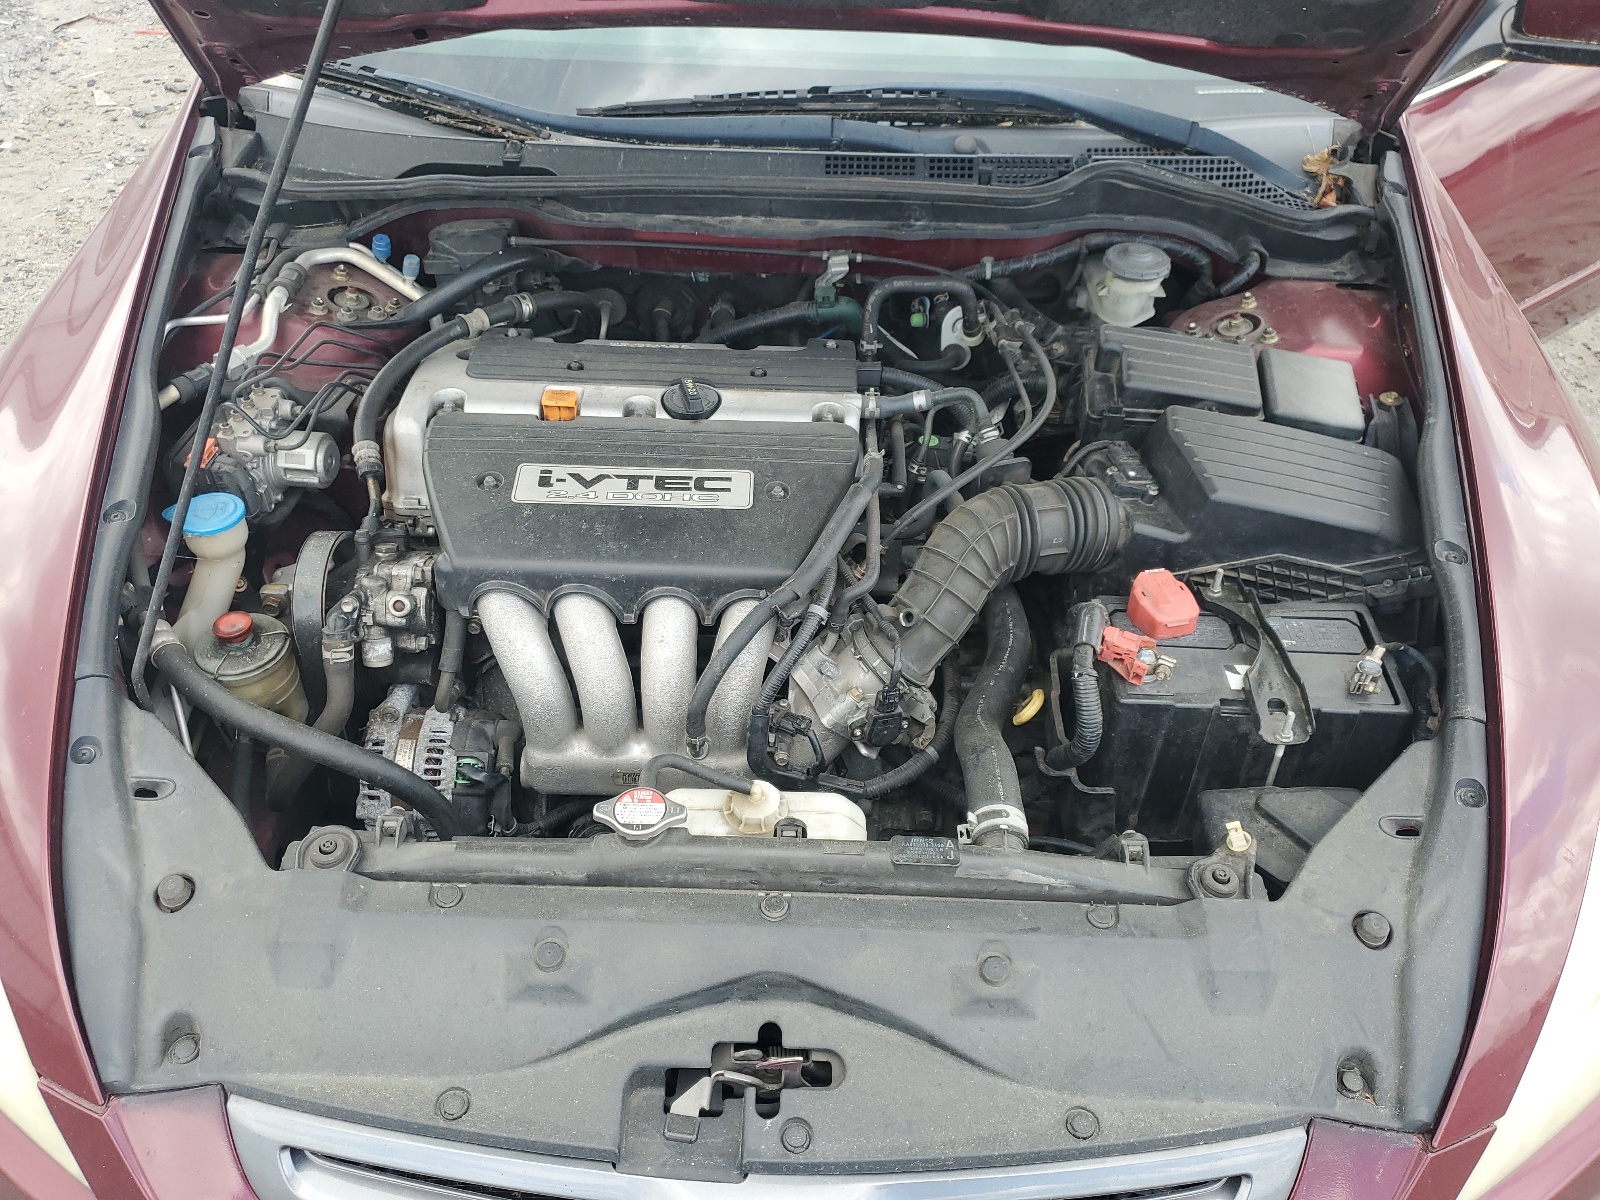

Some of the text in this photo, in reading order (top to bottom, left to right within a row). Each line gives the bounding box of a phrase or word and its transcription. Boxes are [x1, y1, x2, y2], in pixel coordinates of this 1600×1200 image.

[537, 469, 733, 492] i-VTEC
[546, 489, 720, 503] 2.4 DOHC
[946, 839, 955, 850] A
[946, 849, 955, 860] J
